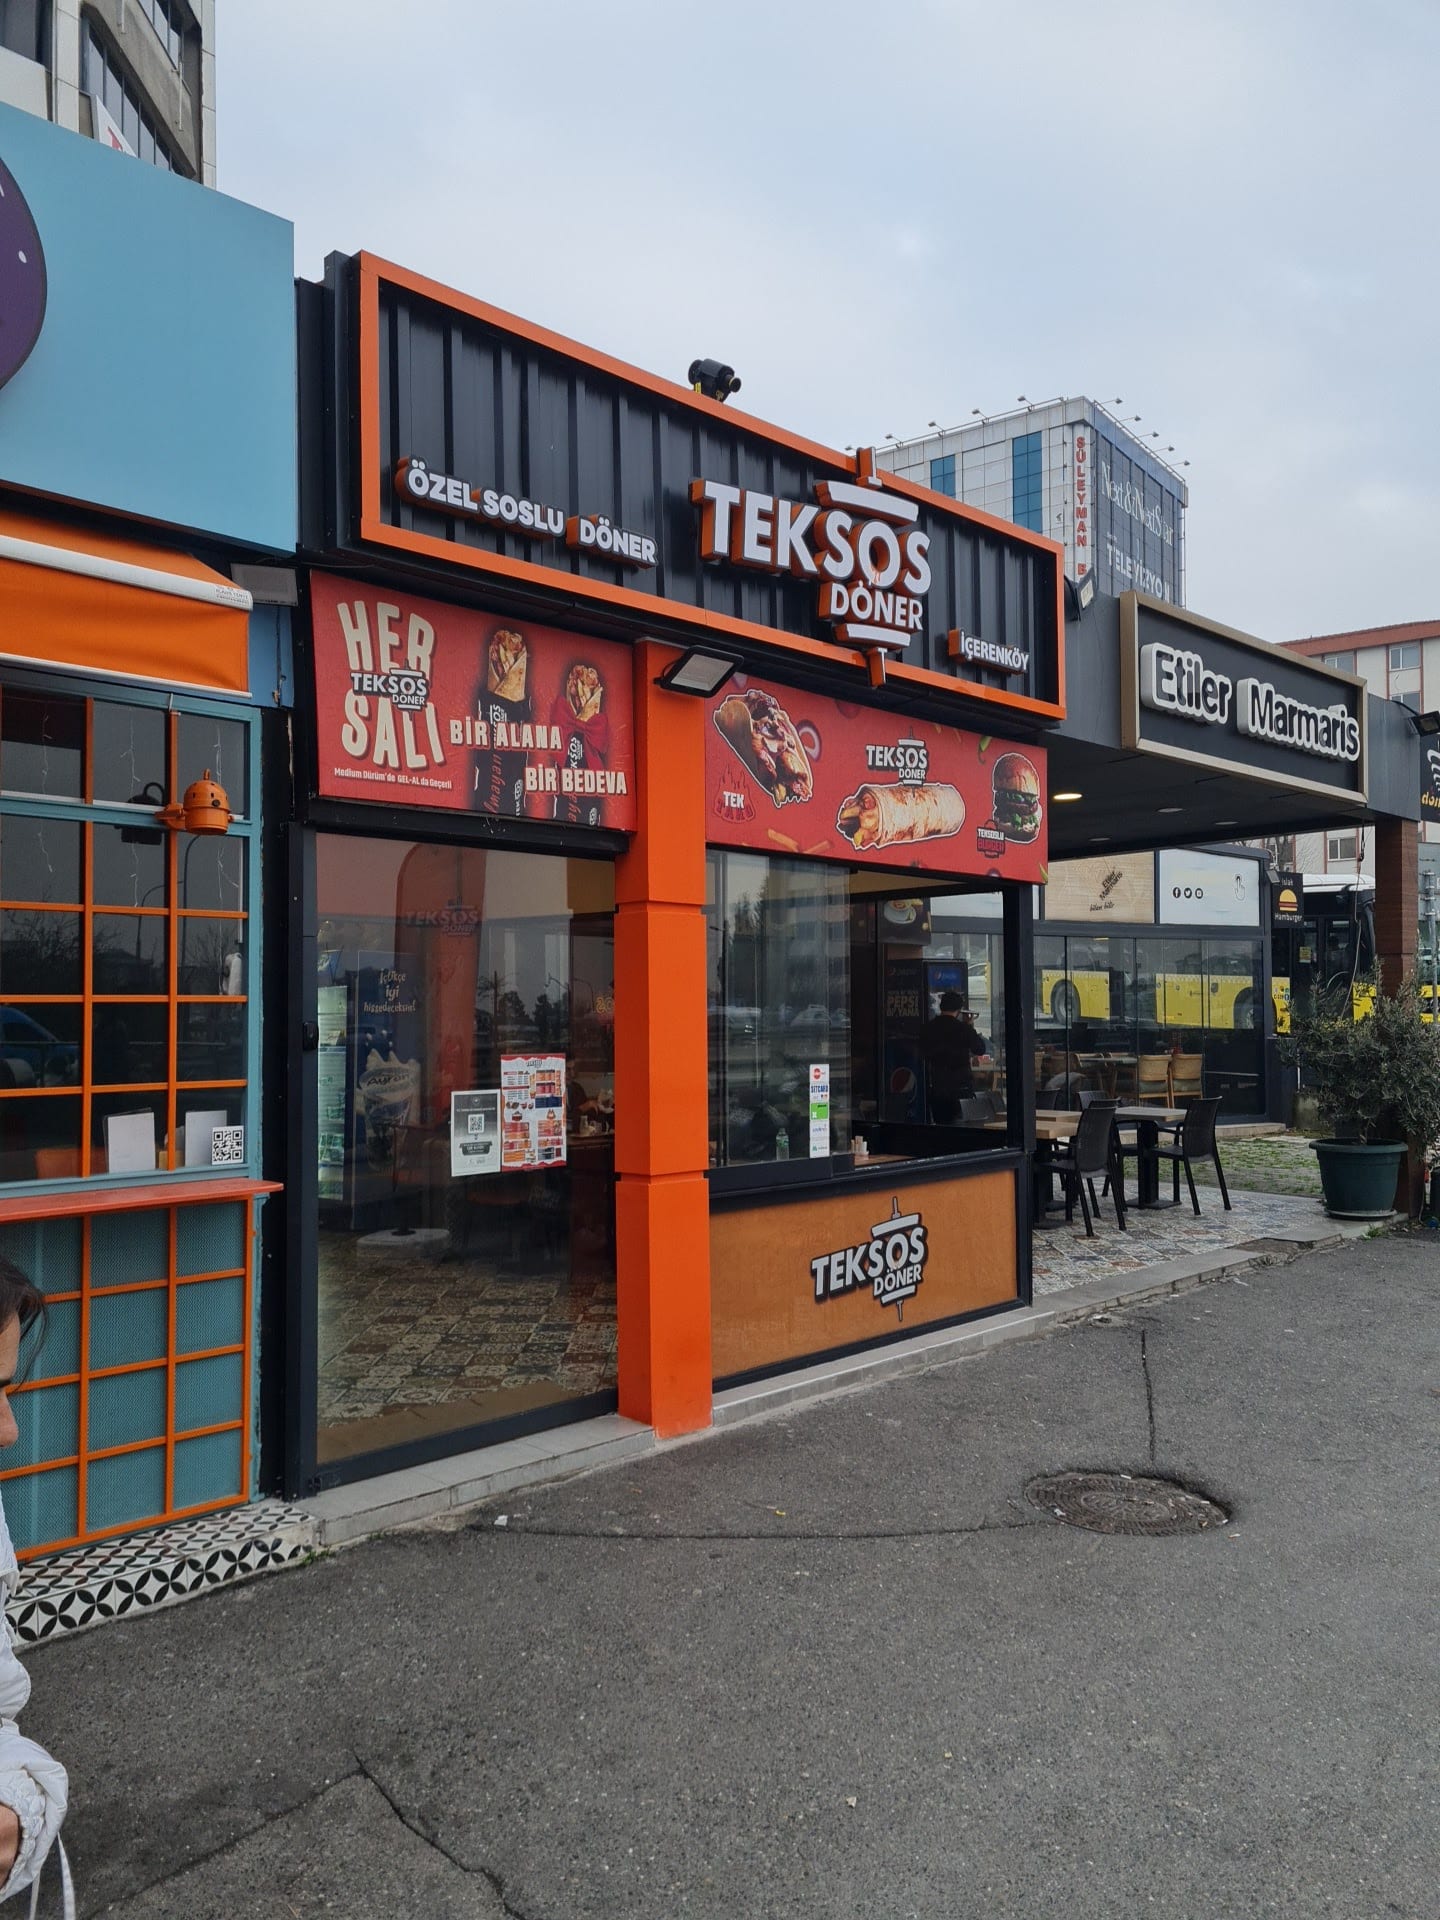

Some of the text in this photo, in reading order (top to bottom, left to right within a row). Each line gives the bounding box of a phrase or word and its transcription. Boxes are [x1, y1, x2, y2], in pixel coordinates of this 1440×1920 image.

[1076, 436, 1088, 547] SÜLEYMAN
[407, 459, 657, 564] ÖZEL SOSLU DÖNER
[703, 480, 932, 595] TEKSOS
[829, 580, 924, 630] DÖNER
[337, 600, 434, 680] HER
[961, 631, 1029, 670] İÇERENKÖY
[351, 673, 427, 696] TEKSOS
[392, 693, 425, 705] DÖNER
[1155, 649, 1359, 757] Etiler Marmaris
[341, 689, 445, 769] SALI
[450, 716, 488, 746] BİR
[496, 723, 562, 749] ALANA
[866, 744, 928, 769] TEKSOS
[899, 766, 926, 779] DÖNER
[334, 768, 362, 778] Medium
[397, 774, 420, 785] GEL-AL
[429, 778, 453, 790] Geçerli
[525, 763, 627, 795] BİR BEDEVA
[1274, 912, 1303, 923] Hamburger
[811, 1227, 925, 1296] TEKSOS
[873, 1263, 922, 1296] DÖNER
